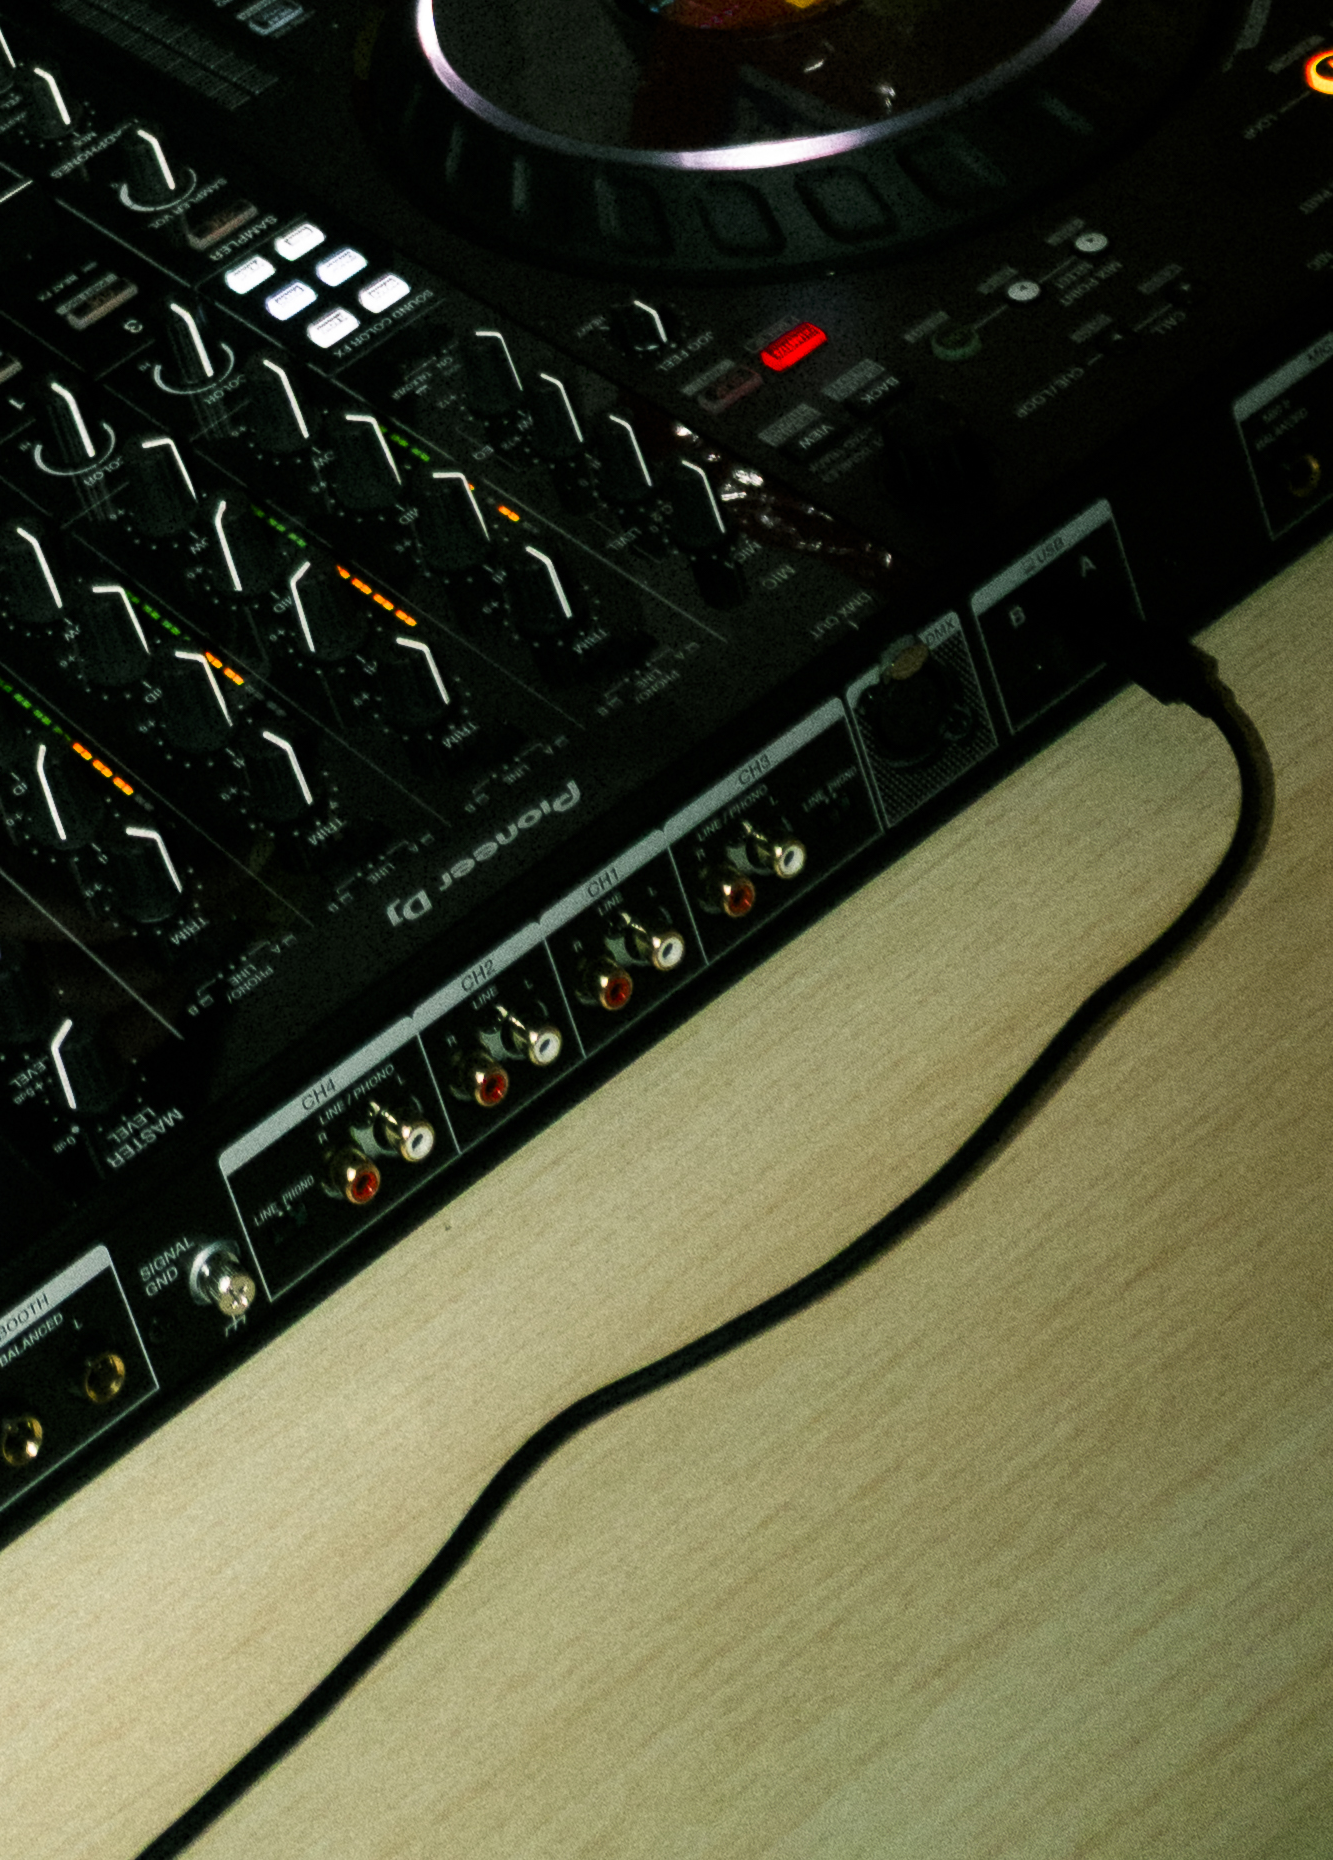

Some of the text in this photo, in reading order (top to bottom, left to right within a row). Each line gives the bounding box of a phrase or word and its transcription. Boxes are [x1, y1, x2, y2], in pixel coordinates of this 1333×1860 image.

[178, 176, 226, 212] SAMPLER
[209, 212, 276, 262] SAMPLER
[52, 273, 77, 292] BEAT
[392, 287, 432, 319] SOUND
[119, 314, 145, 339] 3
[351, 316, 391, 347] COLOR
[1149, 308, 1185, 338] CALL
[331, 342, 352, 361] FX
[685, 330, 714, 353] JOG
[655, 347, 688, 375] FEEL
[3, 390, 27, 415] 1
[860, 374, 899, 407] BACK
[1014, 364, 1084, 419] CUE/LOOP
[796, 419, 833, 451] VIEW
[605, 525, 639, 553] LEVEL
[731, 539, 761, 563] MIC
[1036, 536, 1068, 565] USB
[760, 561, 794, 591] MIC
[1073, 550, 1101, 579] A
[807, 590, 870, 639] DMX OUT
[1002, 601, 1031, 630] B
[571, 626, 607, 656] TRIM
[440, 719, 478, 750] TRIM
[501, 763, 529, 785] LINE
[736, 753, 773, 786] CH3
[694, 783, 771, 843] LINE PHONO
[304, 813, 345, 847] TRIM
[365, 861, 394, 884] LINE
[379, 781, 579, 933] Pioneer DJ
[585, 867, 622, 898] CH1
[595, 891, 626, 917] LINE
[167, 912, 208, 946] TRIM
[225, 962, 255, 986] LINE
[459, 959, 498, 993] CH2
[470, 983, 501, 1010] LINE
[444, 1031, 460, 1047] R
[300, 1077, 339, 1112] CH4
[317, 1062, 398, 1126] LINE PHONO
[104, 1105, 155, 1146] LEVEL
[104, 1106, 183, 1169] MASTER
[314, 1129, 331, 1146] R
[251, 1173, 317, 1227] LINE PHONO
[138, 1235, 195, 1281] SIGNAL
[142, 1263, 182, 1297] GND
